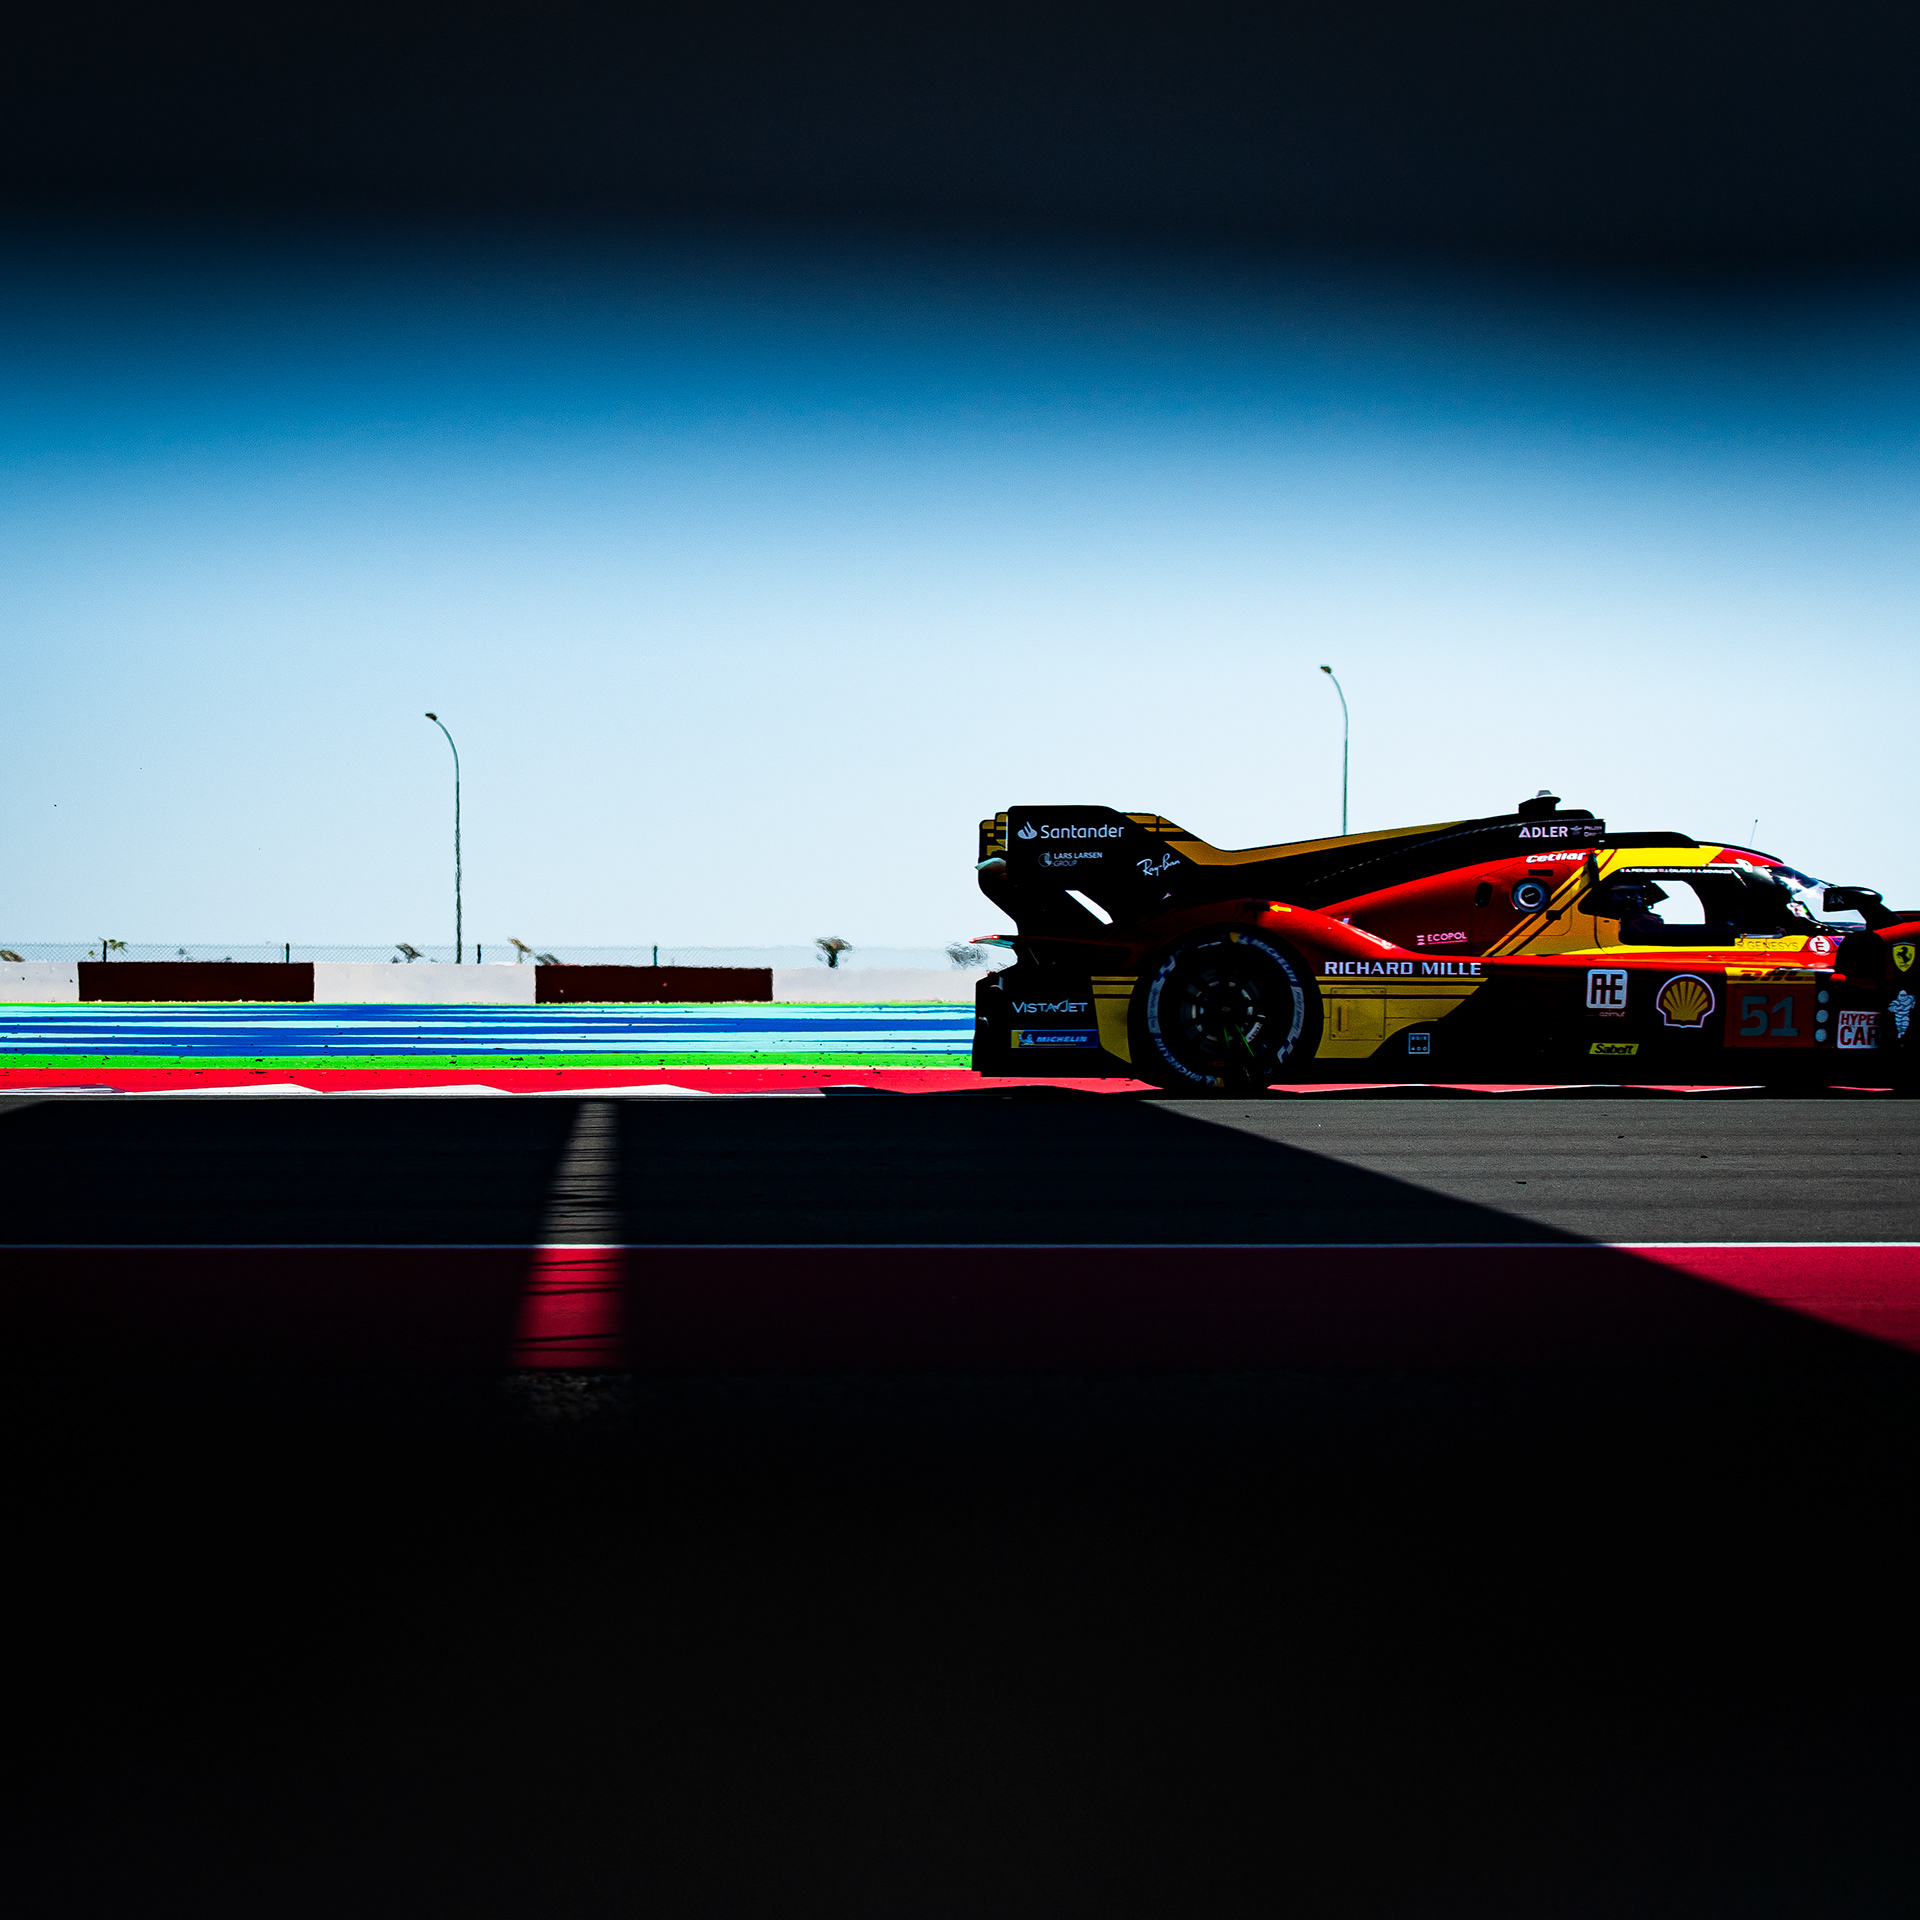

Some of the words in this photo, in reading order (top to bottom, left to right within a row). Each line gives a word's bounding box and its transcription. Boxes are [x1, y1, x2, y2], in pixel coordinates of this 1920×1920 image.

[1040, 824, 1125, 839] Santander
[1518, 826, 1569, 838] ADLER
[1053, 852, 1073, 860] LARS
[1074, 851, 1104, 859] LARSEN
[1136, 853, 1182, 876] Ray-Ban
[1427, 932, 1468, 942] ECOPOL
[1747, 941, 1800, 950] GENESYS
[1324, 961, 1414, 975] RICHARD
[1421, 962, 1482, 976] MILLE
[1739, 969, 1804, 981] DHL
[1011, 998, 1089, 1014] VISTAJET
[1740, 995, 1800, 1037] 51
[1840, 1025, 1881, 1046] CAR
[1153, 1038, 1204, 1082] MICHELIN
